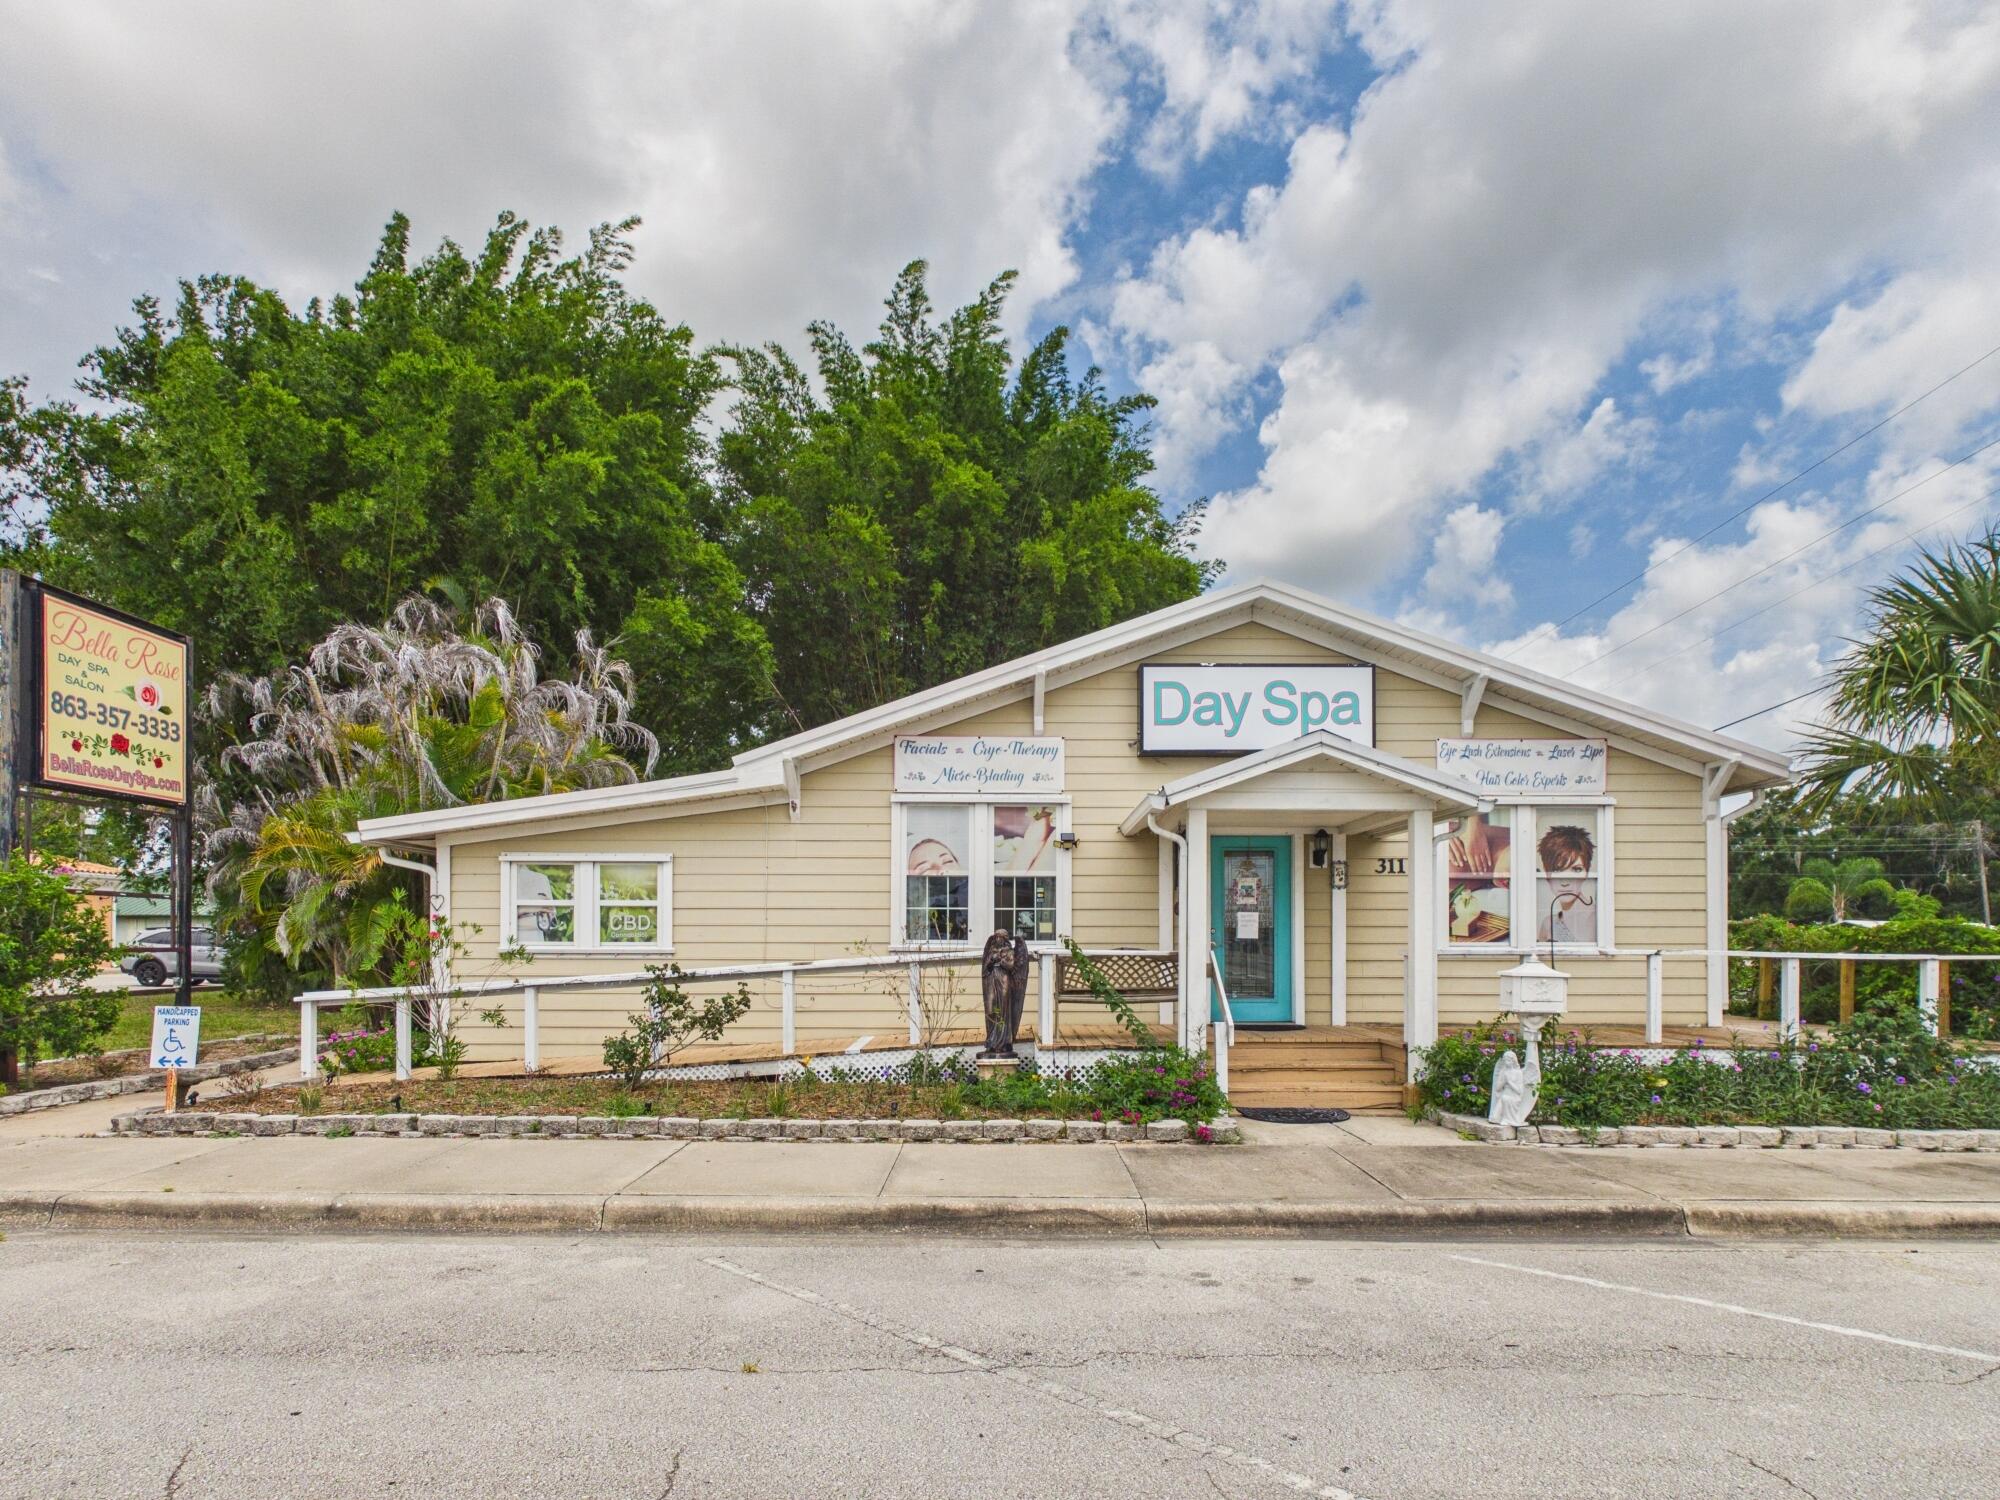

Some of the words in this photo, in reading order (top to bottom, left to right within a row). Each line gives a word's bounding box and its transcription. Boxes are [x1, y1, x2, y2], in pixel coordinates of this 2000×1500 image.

[50, 611, 119, 663] Bella
[125, 637, 180, 681] Rose
[58, 653, 82, 668] DAY
[87, 662, 110, 676] SPA
[81, 671, 88, 679] &
[65, 675, 105, 694] SALON
[51, 690, 181, 743] 863-357-3333
[1153, 680, 1252, 738] Day
[1262, 679, 1362, 736] Spa
[899, 739, 948, 755] Facials
[972, 740, 1059, 762] Cryo-Therapy
[1439, 742, 1458, 763] Eye
[1485, 743, 1532, 760] Extensions
[1548, 744, 1576, 760] Laser
[1579, 744, 1605, 761] Lipo
[50, 753, 181, 793] BellaRoseDaySpa.com
[932, 766, 1025, 788] Micro-Blading
[1475, 768, 1502, 786] Hair
[1504, 770, 1530, 786] Color
[1532, 771, 1568, 790] Experts
[1375, 858, 1406, 874] 311
[610, 914, 651, 931] CBD
[158, 1008, 198, 1016] HANDICAPPED
[164, 1018, 190, 1026] PARKING
